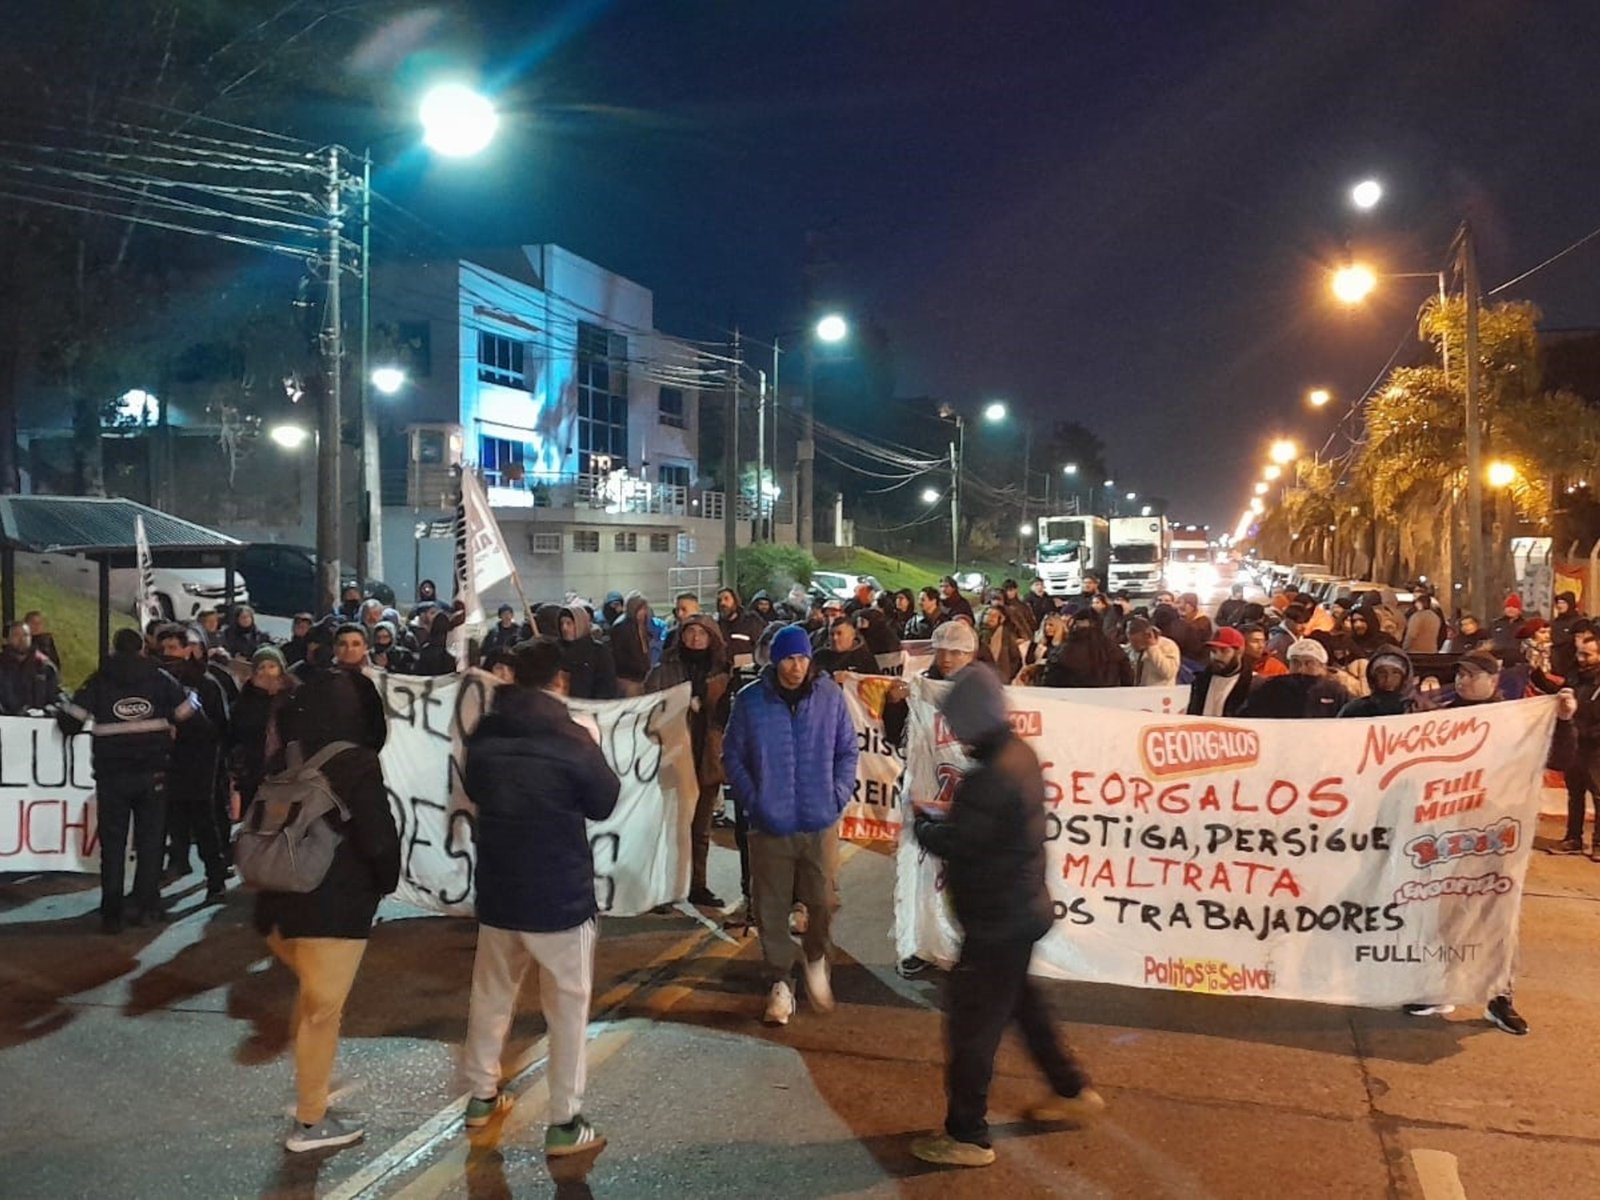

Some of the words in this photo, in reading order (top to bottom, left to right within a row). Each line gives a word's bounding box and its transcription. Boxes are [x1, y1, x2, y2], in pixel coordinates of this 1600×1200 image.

[1146, 729, 1257, 768] GEORGALOS
[1041, 761, 1349, 818] GEORGALOS
[1062, 853, 1302, 898] MALTRATA
[1103, 895, 1404, 941] TRABAJADORES
[1144, 955, 1204, 988] Palitos
[1219, 962, 1270, 992] Selva
